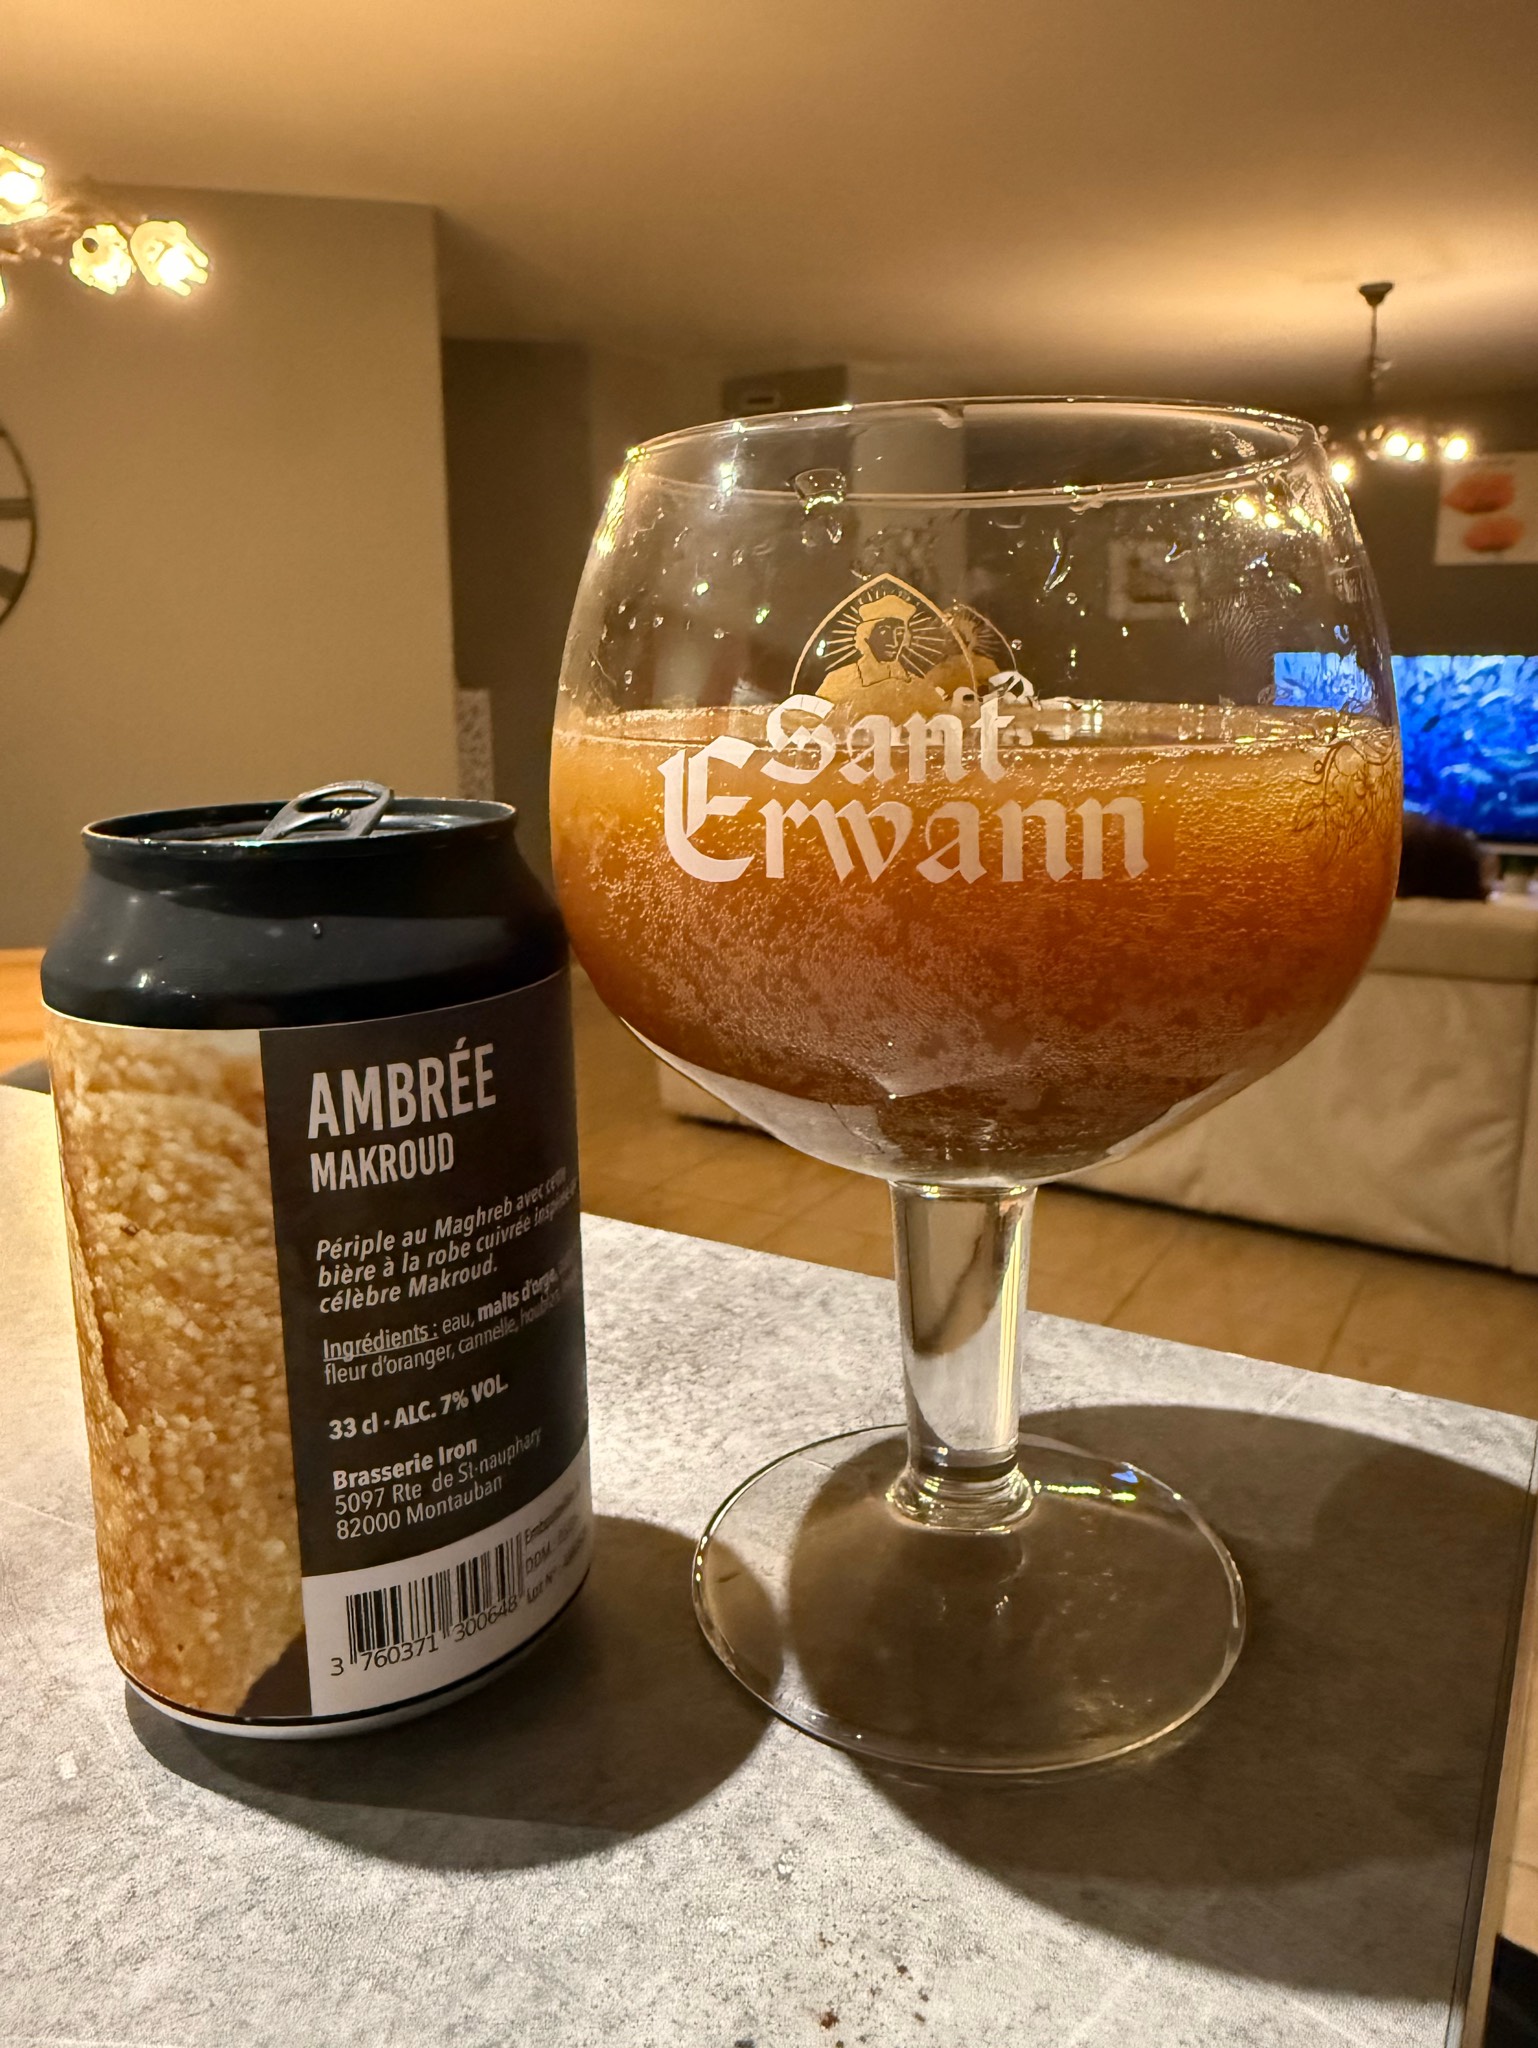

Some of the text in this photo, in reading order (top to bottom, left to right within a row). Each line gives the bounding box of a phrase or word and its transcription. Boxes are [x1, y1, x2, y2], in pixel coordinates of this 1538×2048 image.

[760, 694, 1015, 785] Sant
[657, 735, 1149, 884] Erwann
[308, 1036, 496, 1139] AMBRÉE
[310, 1132, 455, 1193] MAKROUD
[316, 1229, 395, 1262] Périple
[401, 1228, 427, 1248] au
[434, 1195, 512, 1240] Maghreb
[318, 1264, 376, 1287] bière
[382, 1256, 394, 1278] à
[401, 1251, 420, 1274] la
[426, 1240, 471, 1269] robe
[475, 1214, 531, 1253] cuivrée
[319, 1252, 498, 1314] célèbre Makroud.
[442, 1315, 476, 1335] eau,
[477, 1291, 519, 1322] malts
[324, 1362, 367, 1386] fleur
[328, 1418, 357, 1440] 33
[361, 1412, 378, 1435] cl
[393, 1400, 436, 1430] ALC.
[440, 1388, 470, 1415] 7%
[471, 1373, 508, 1403] VOL.
[333, 1438, 478, 1491] Brasserie Iron
[334, 1488, 385, 1516] 5097
[392, 1482, 422, 1504] Rte
[431, 1470, 453, 1493] de
[336, 1509, 400, 1540] 82000
[406, 1475, 503, 1526] Montauban
[330, 1595, 518, 1677] 3 760371 300648
